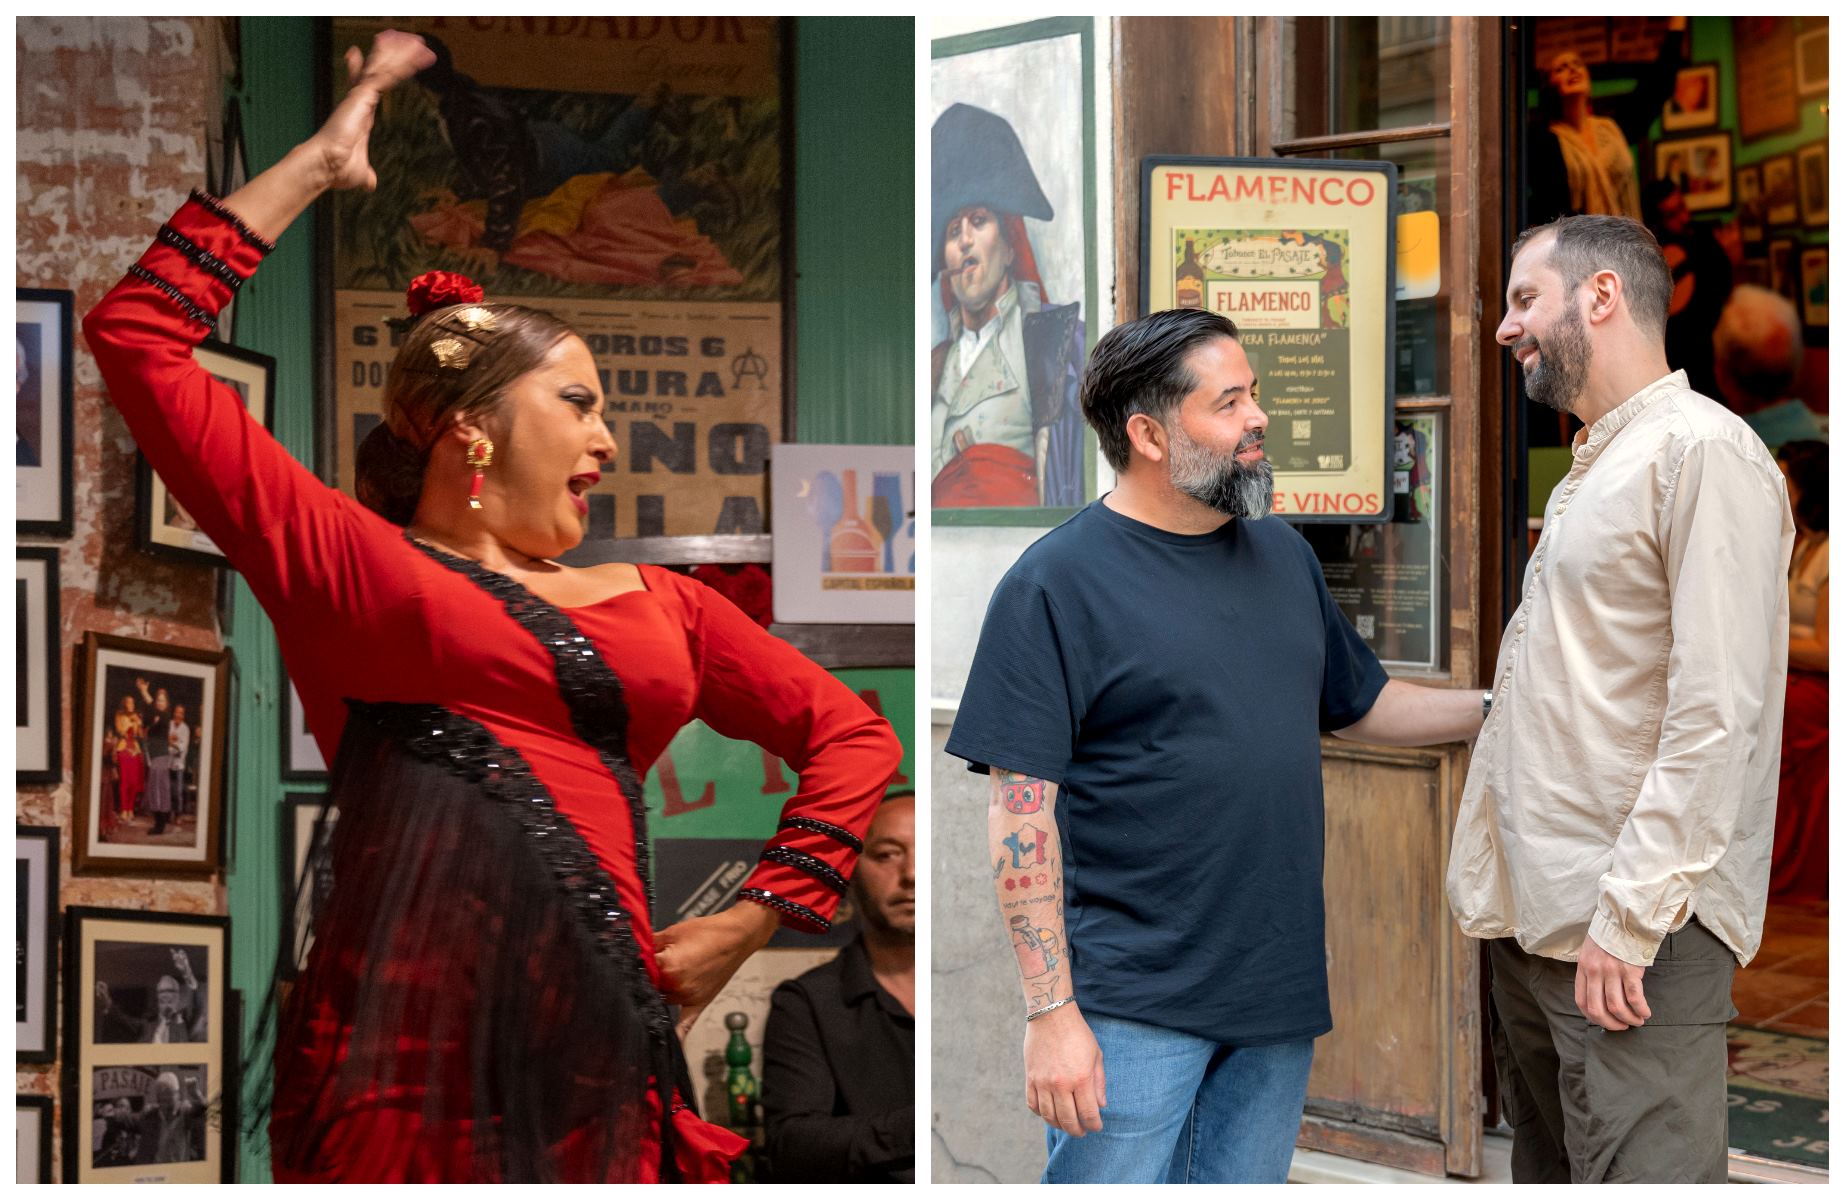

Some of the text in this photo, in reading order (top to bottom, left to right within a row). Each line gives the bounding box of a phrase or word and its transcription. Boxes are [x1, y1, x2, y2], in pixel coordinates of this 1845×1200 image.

[1165, 172, 1375, 206] FLAMENCO
[1271, 247, 1311, 264] PASAJE
[1216, 291, 1311, 311] FLAMENCO
[1293, 493, 1379, 514] VINOS
